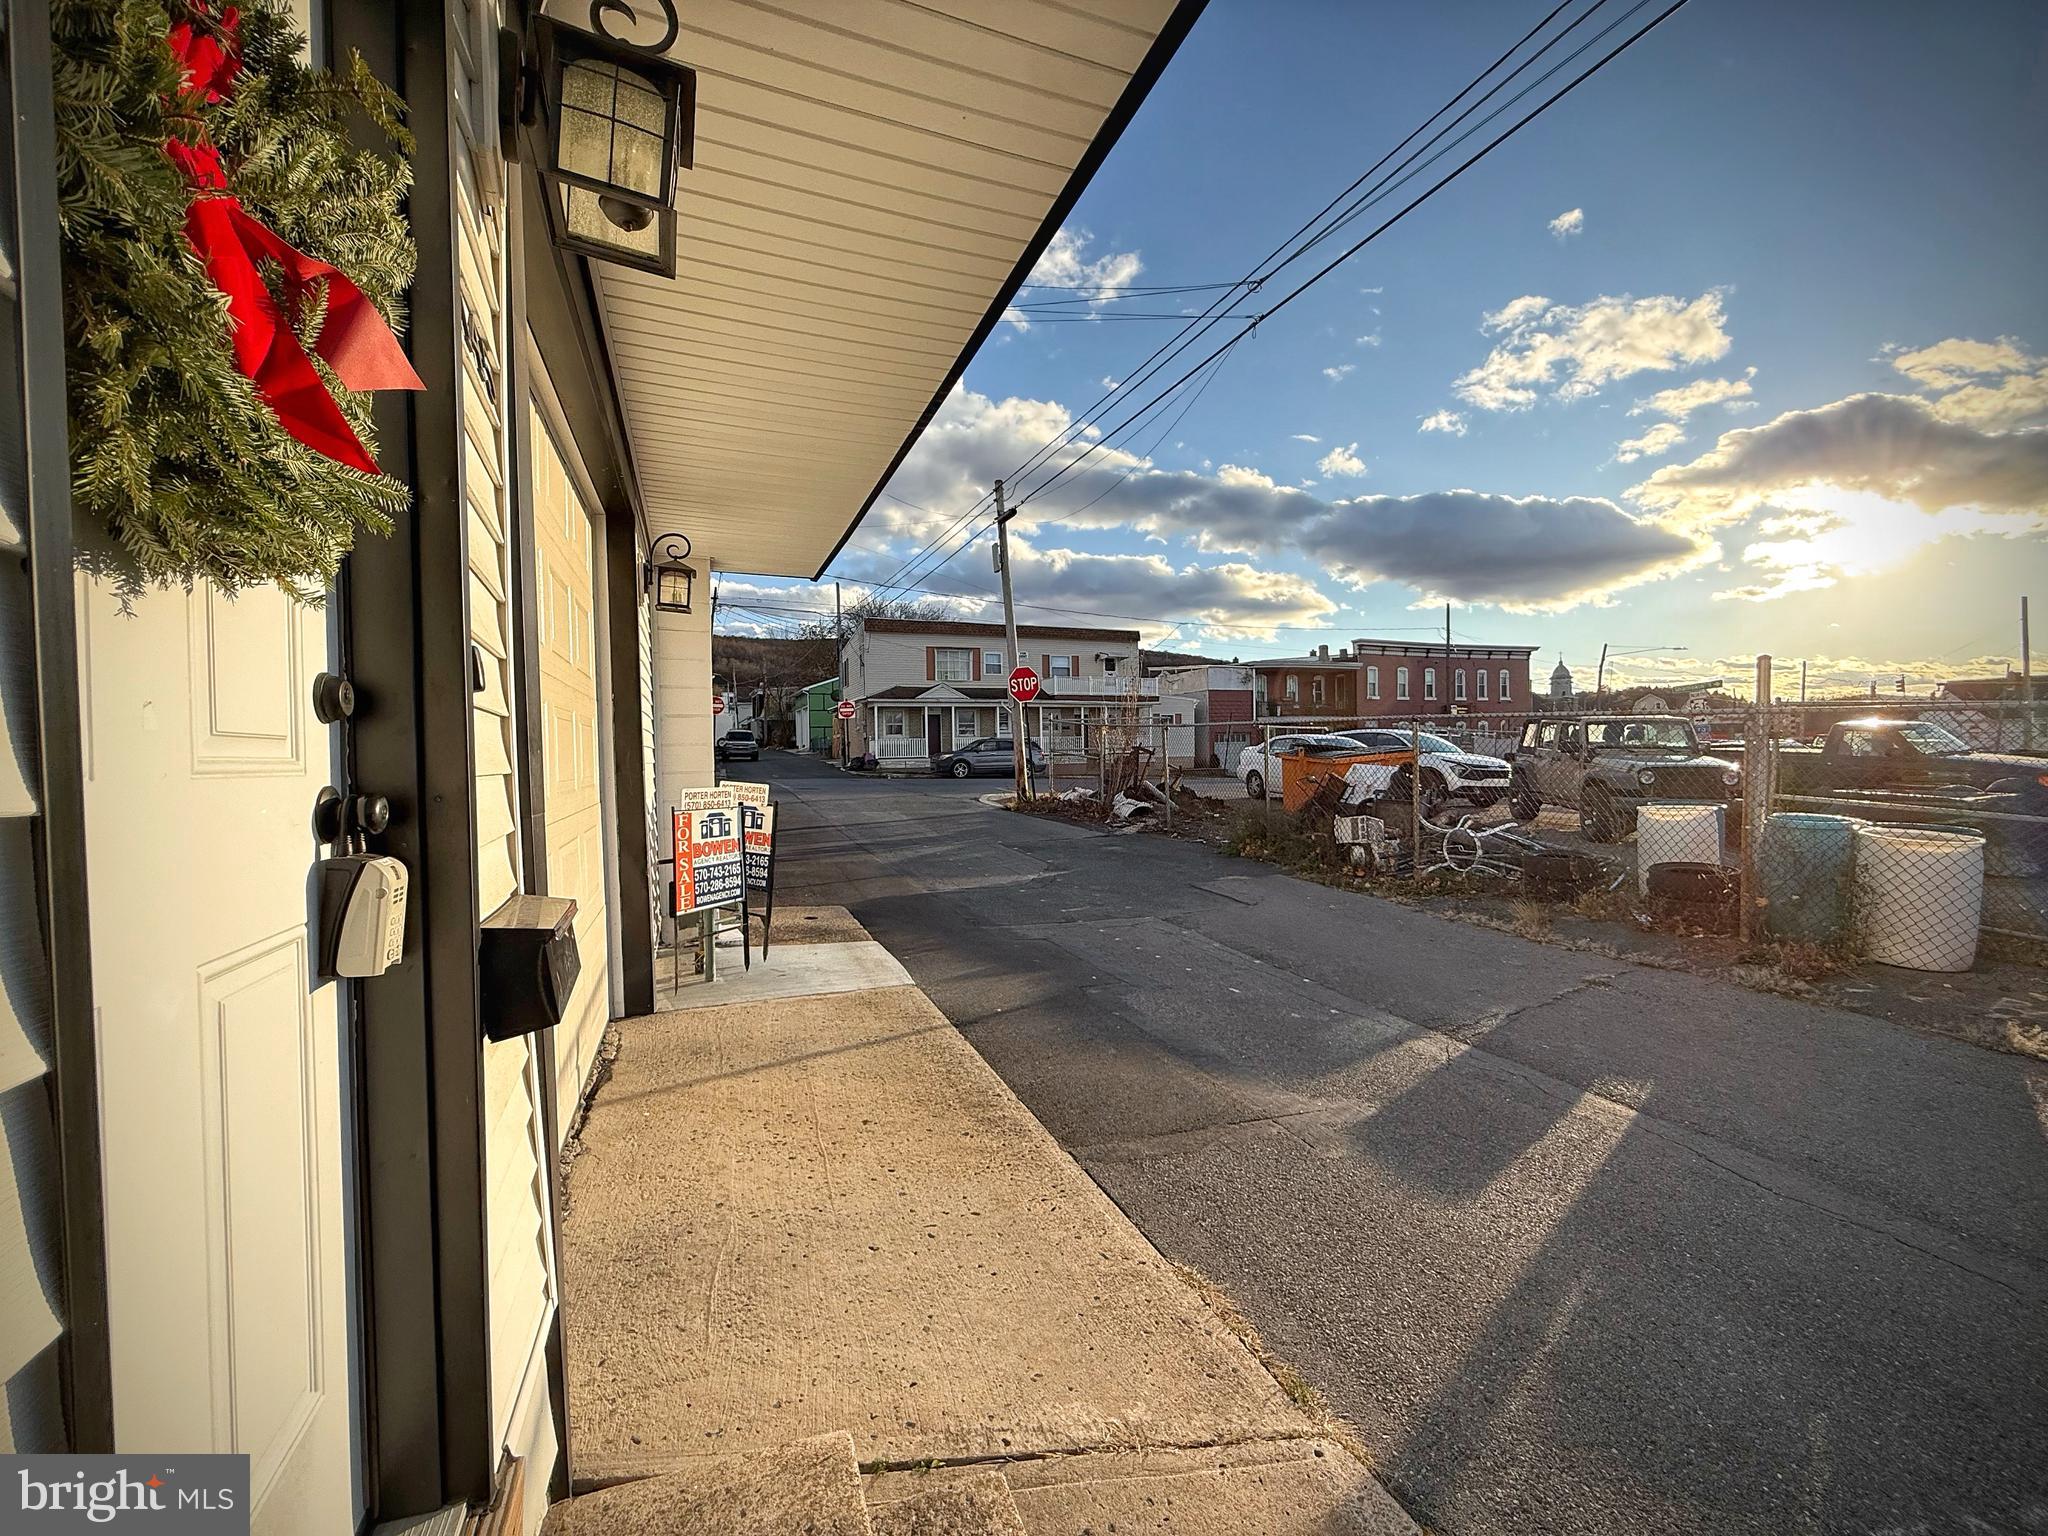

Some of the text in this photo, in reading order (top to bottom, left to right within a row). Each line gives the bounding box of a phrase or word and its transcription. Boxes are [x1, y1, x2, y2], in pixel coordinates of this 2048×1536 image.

[1011, 677, 1037, 692] STOP
[684, 791, 731, 800] PORTER HORTEN
[744, 785, 766, 795] HORTEN
[737, 794, 765, 803] 850-6413
[692, 838, 740, 859] BOWEN
[677, 814, 692, 910] FOR SALE
[694, 857, 715, 866] AGENCY
[694, 863, 740, 882] 570-743-2165
[695, 877, 741, 895] 570-286-8594
[697, 888, 740, 905] BOWENAGENCY.COM
